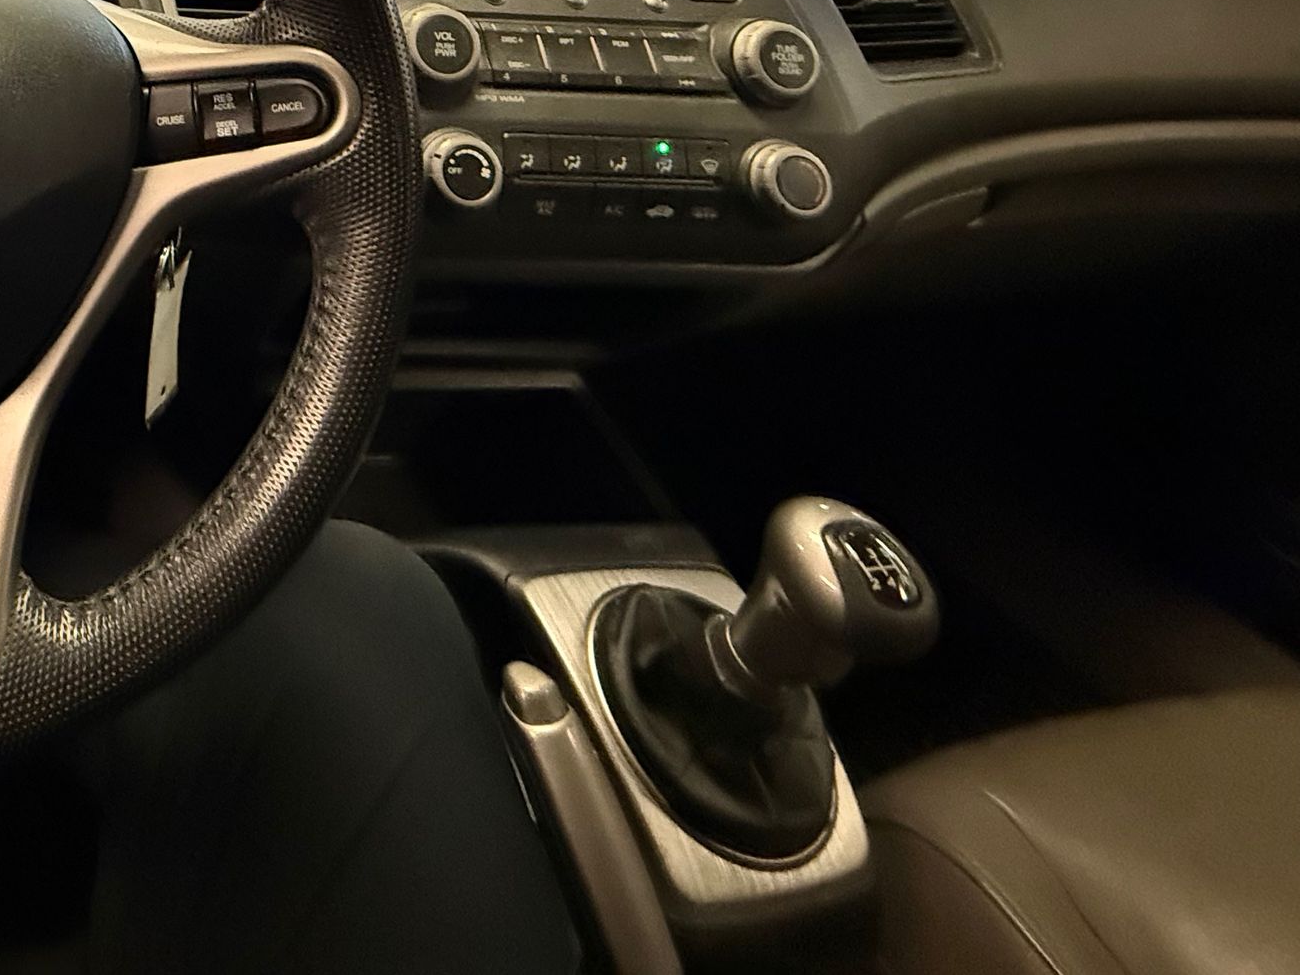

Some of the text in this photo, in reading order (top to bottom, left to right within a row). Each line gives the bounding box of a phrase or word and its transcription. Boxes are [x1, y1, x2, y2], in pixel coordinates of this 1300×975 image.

[433, 31, 456, 41] VOL
[434, 48, 457, 57] PWR
[560, 74, 568, 83] 5
[614, 76, 623, 85] 6
[213, 93, 233, 103] RES
[500, 95, 525, 103] WMA
[271, 101, 306, 114] CANCEL
[156, 114, 186, 126] CRUISE
[216, 127, 239, 137] SET
[447, 166, 463, 175] OFF
